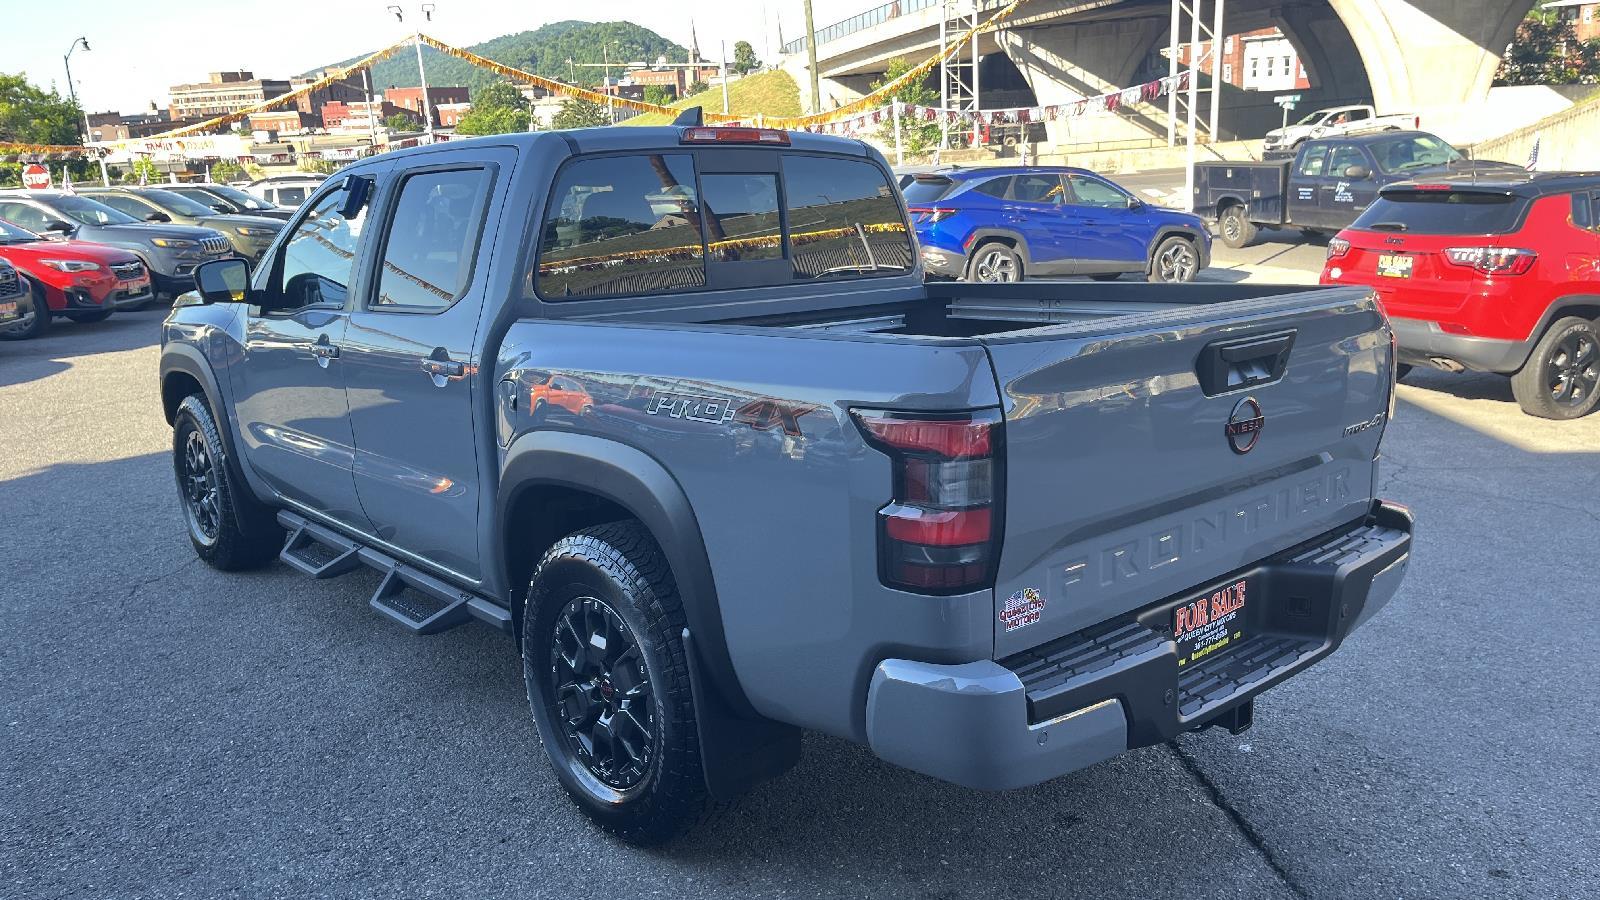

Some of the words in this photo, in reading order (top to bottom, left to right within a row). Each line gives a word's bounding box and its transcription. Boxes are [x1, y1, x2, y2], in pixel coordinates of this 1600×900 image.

[145, 142, 174, 152] FAMILY
[24, 172, 49, 186] STOP
[1227, 417, 1264, 434] NISSAN
[1046, 467, 1351, 602] FRONTIER
[1175, 598, 1208, 637] FOR
[1211, 581, 1246, 621] SALE
